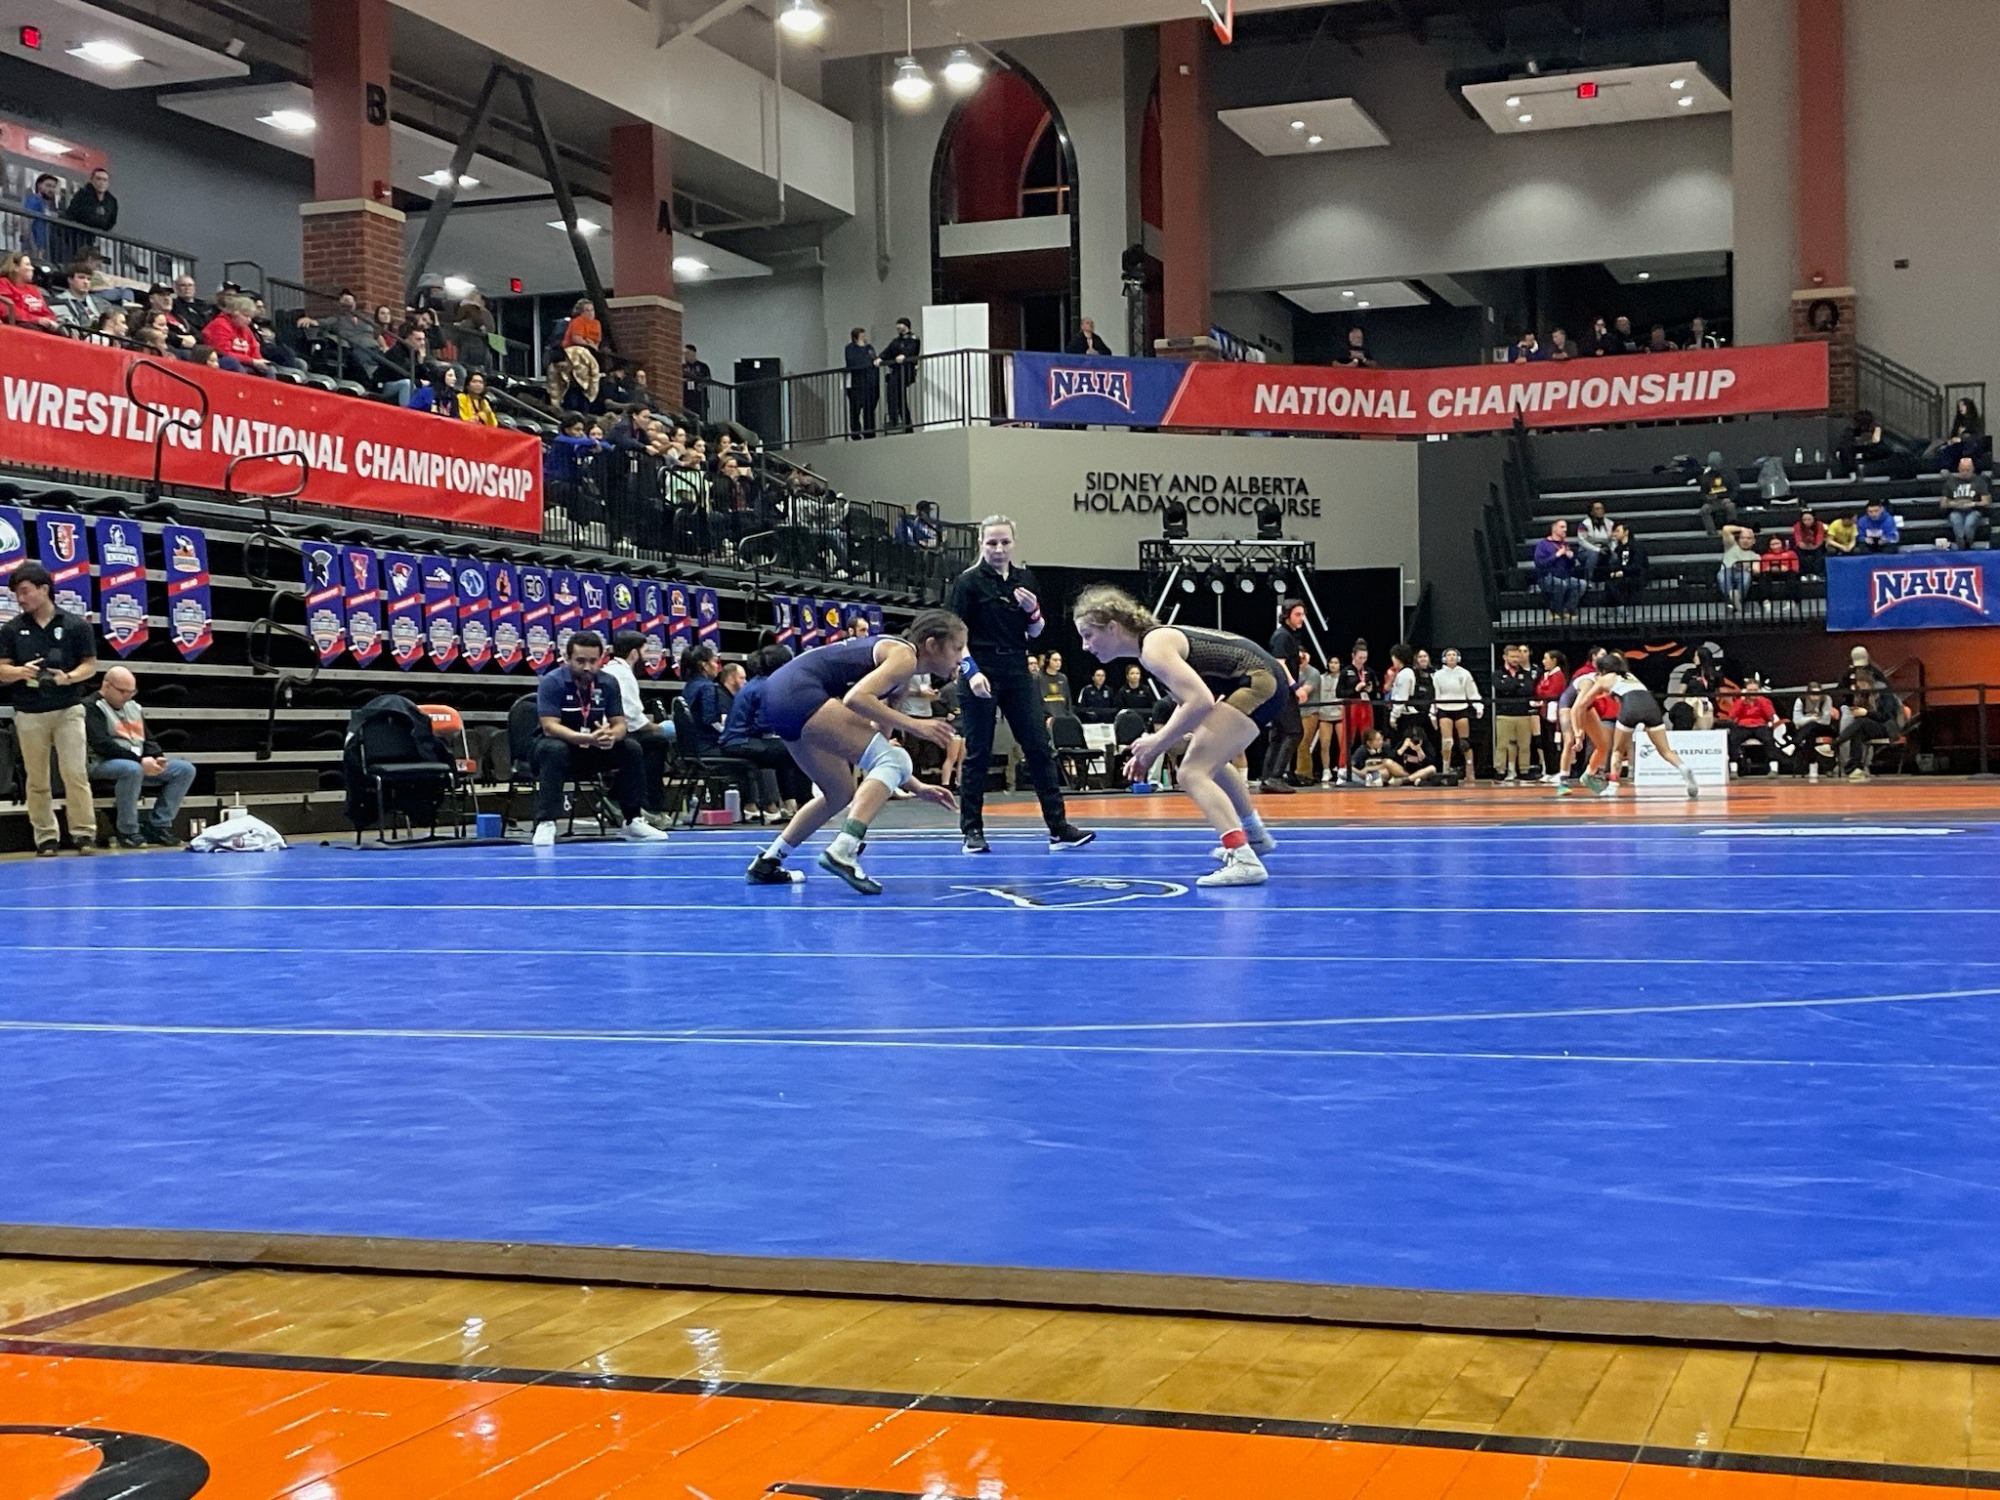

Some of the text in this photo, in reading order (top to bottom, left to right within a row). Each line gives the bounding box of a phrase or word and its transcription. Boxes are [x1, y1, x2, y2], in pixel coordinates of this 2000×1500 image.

[366, 83, 387, 126] B
[657, 200, 672, 235] A
[1049, 368, 1130, 411] NAIA
[1253, 369, 1736, 419] NATIONAL CHAMPIONSHIP
[3, 376, 533, 502] WRESTLING NATIONAL CHAMPIONSHIP
[1086, 472, 1309, 496] SIDNEY AND ALBERTA
[1873, 569, 1983, 614] NAIA
